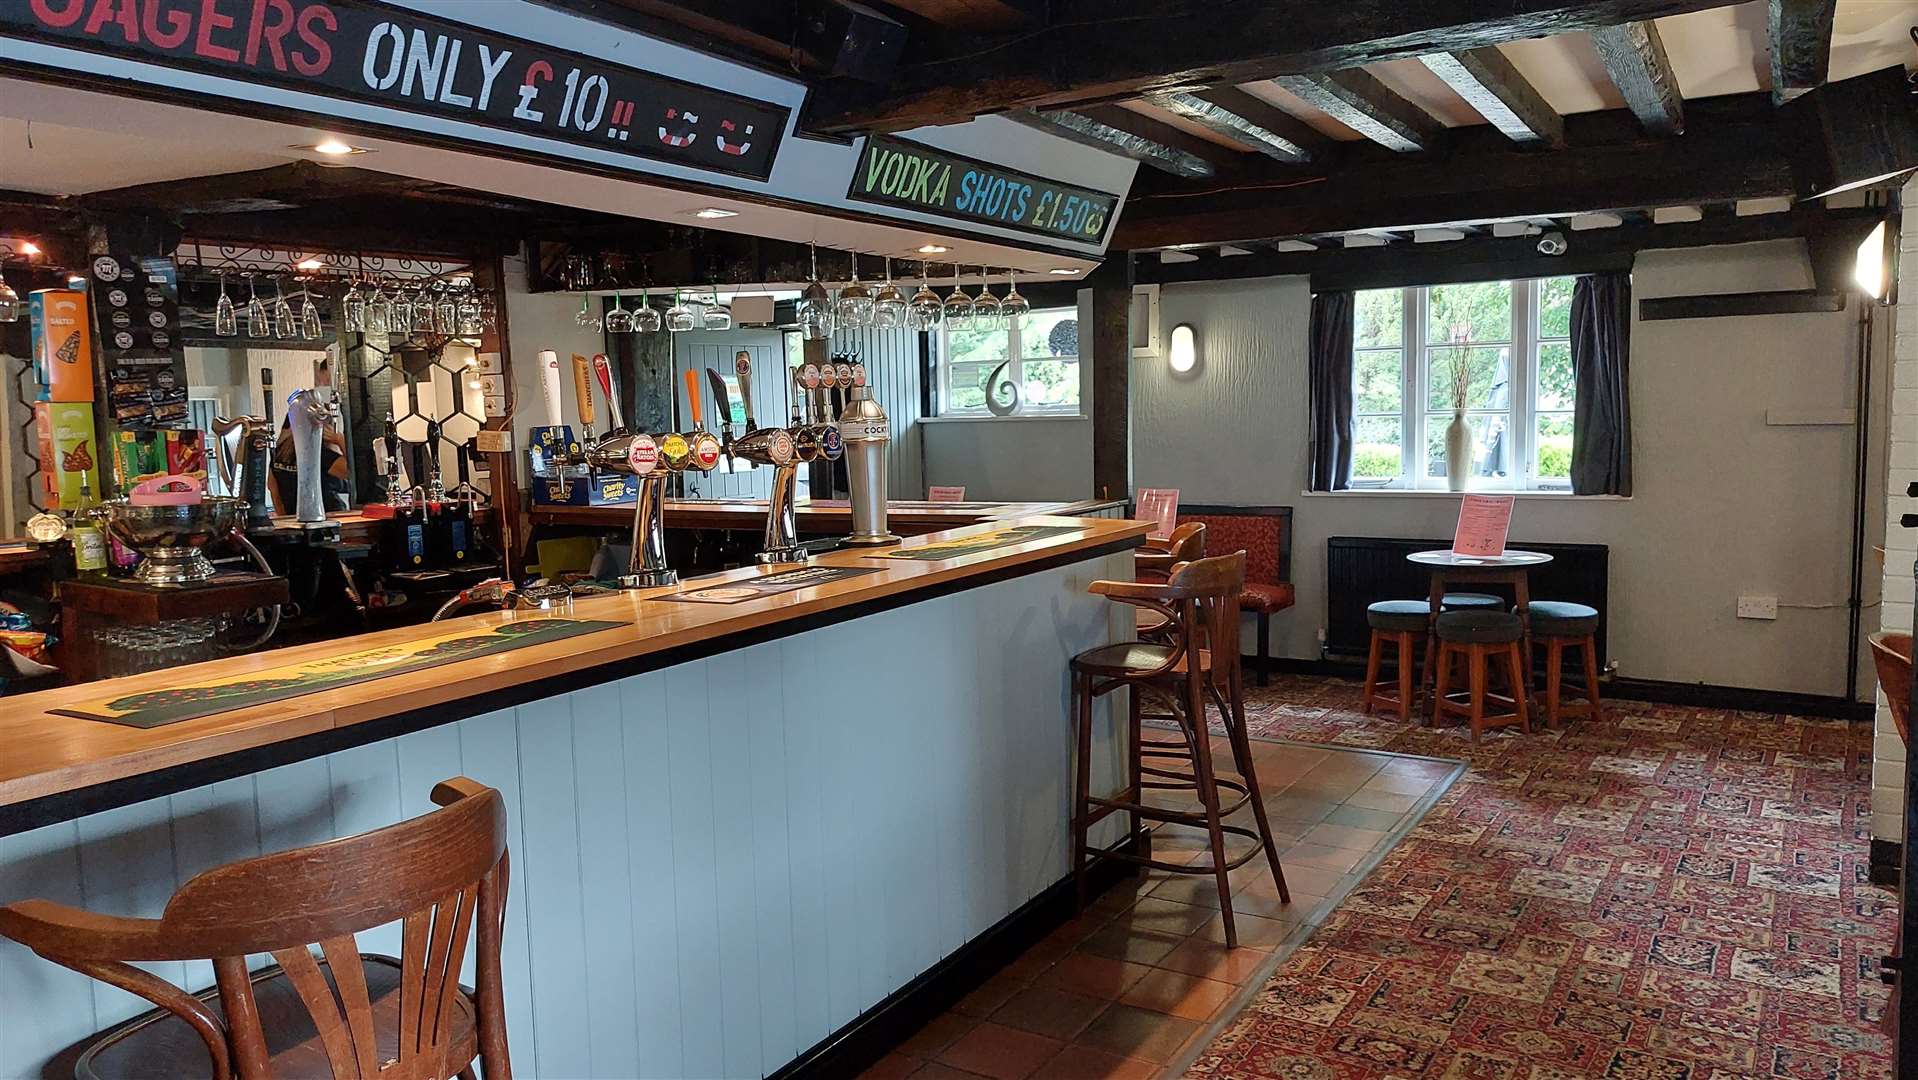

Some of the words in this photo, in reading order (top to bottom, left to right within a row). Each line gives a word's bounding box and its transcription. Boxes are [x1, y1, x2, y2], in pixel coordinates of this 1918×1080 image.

[363, 22, 512, 111] ONLY
[865, 147, 952, 206] VODKA
[956, 170, 1032, 222] SHOTS
[1031, 191, 1090, 235] £1.50
